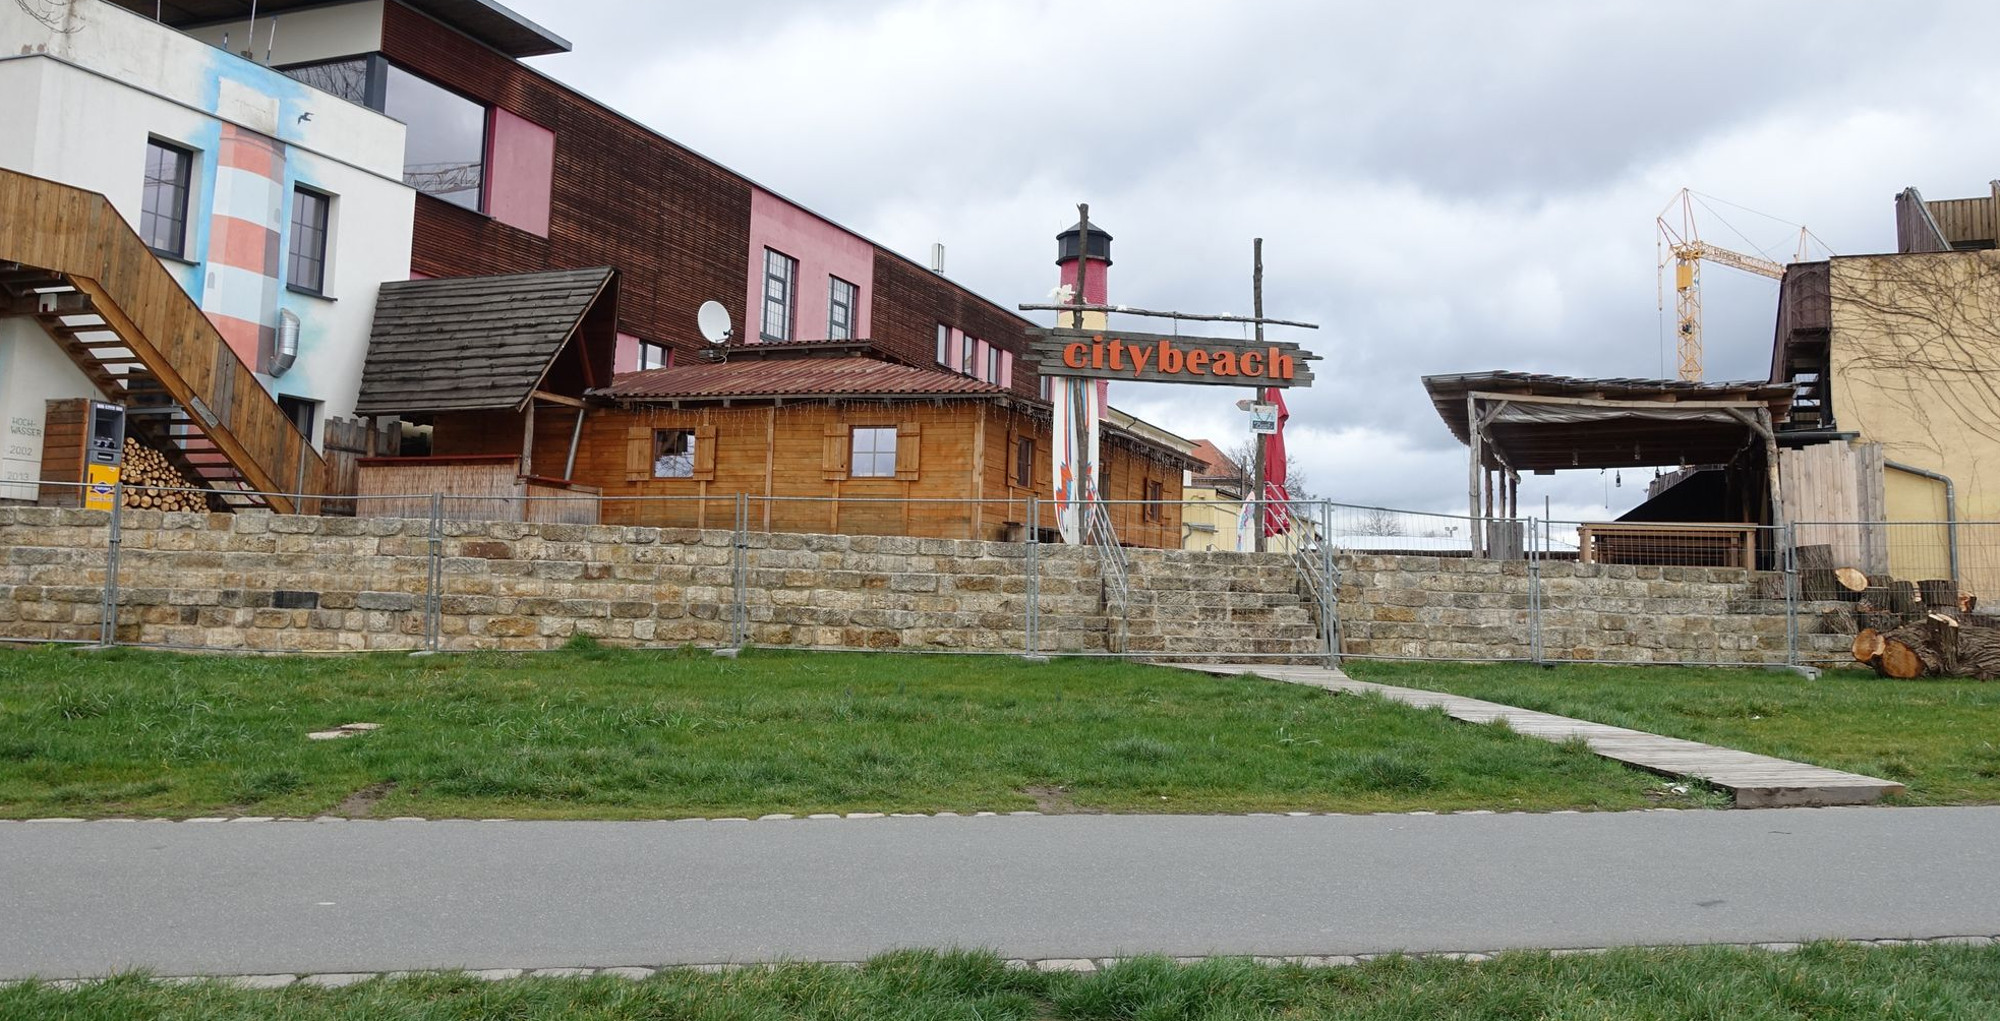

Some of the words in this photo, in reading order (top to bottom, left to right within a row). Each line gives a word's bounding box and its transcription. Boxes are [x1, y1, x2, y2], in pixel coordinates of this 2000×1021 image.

[1063, 335, 1294, 379] citybeach
[10, 425, 42, 437] WASSER
[9, 445, 33, 456] 2002
